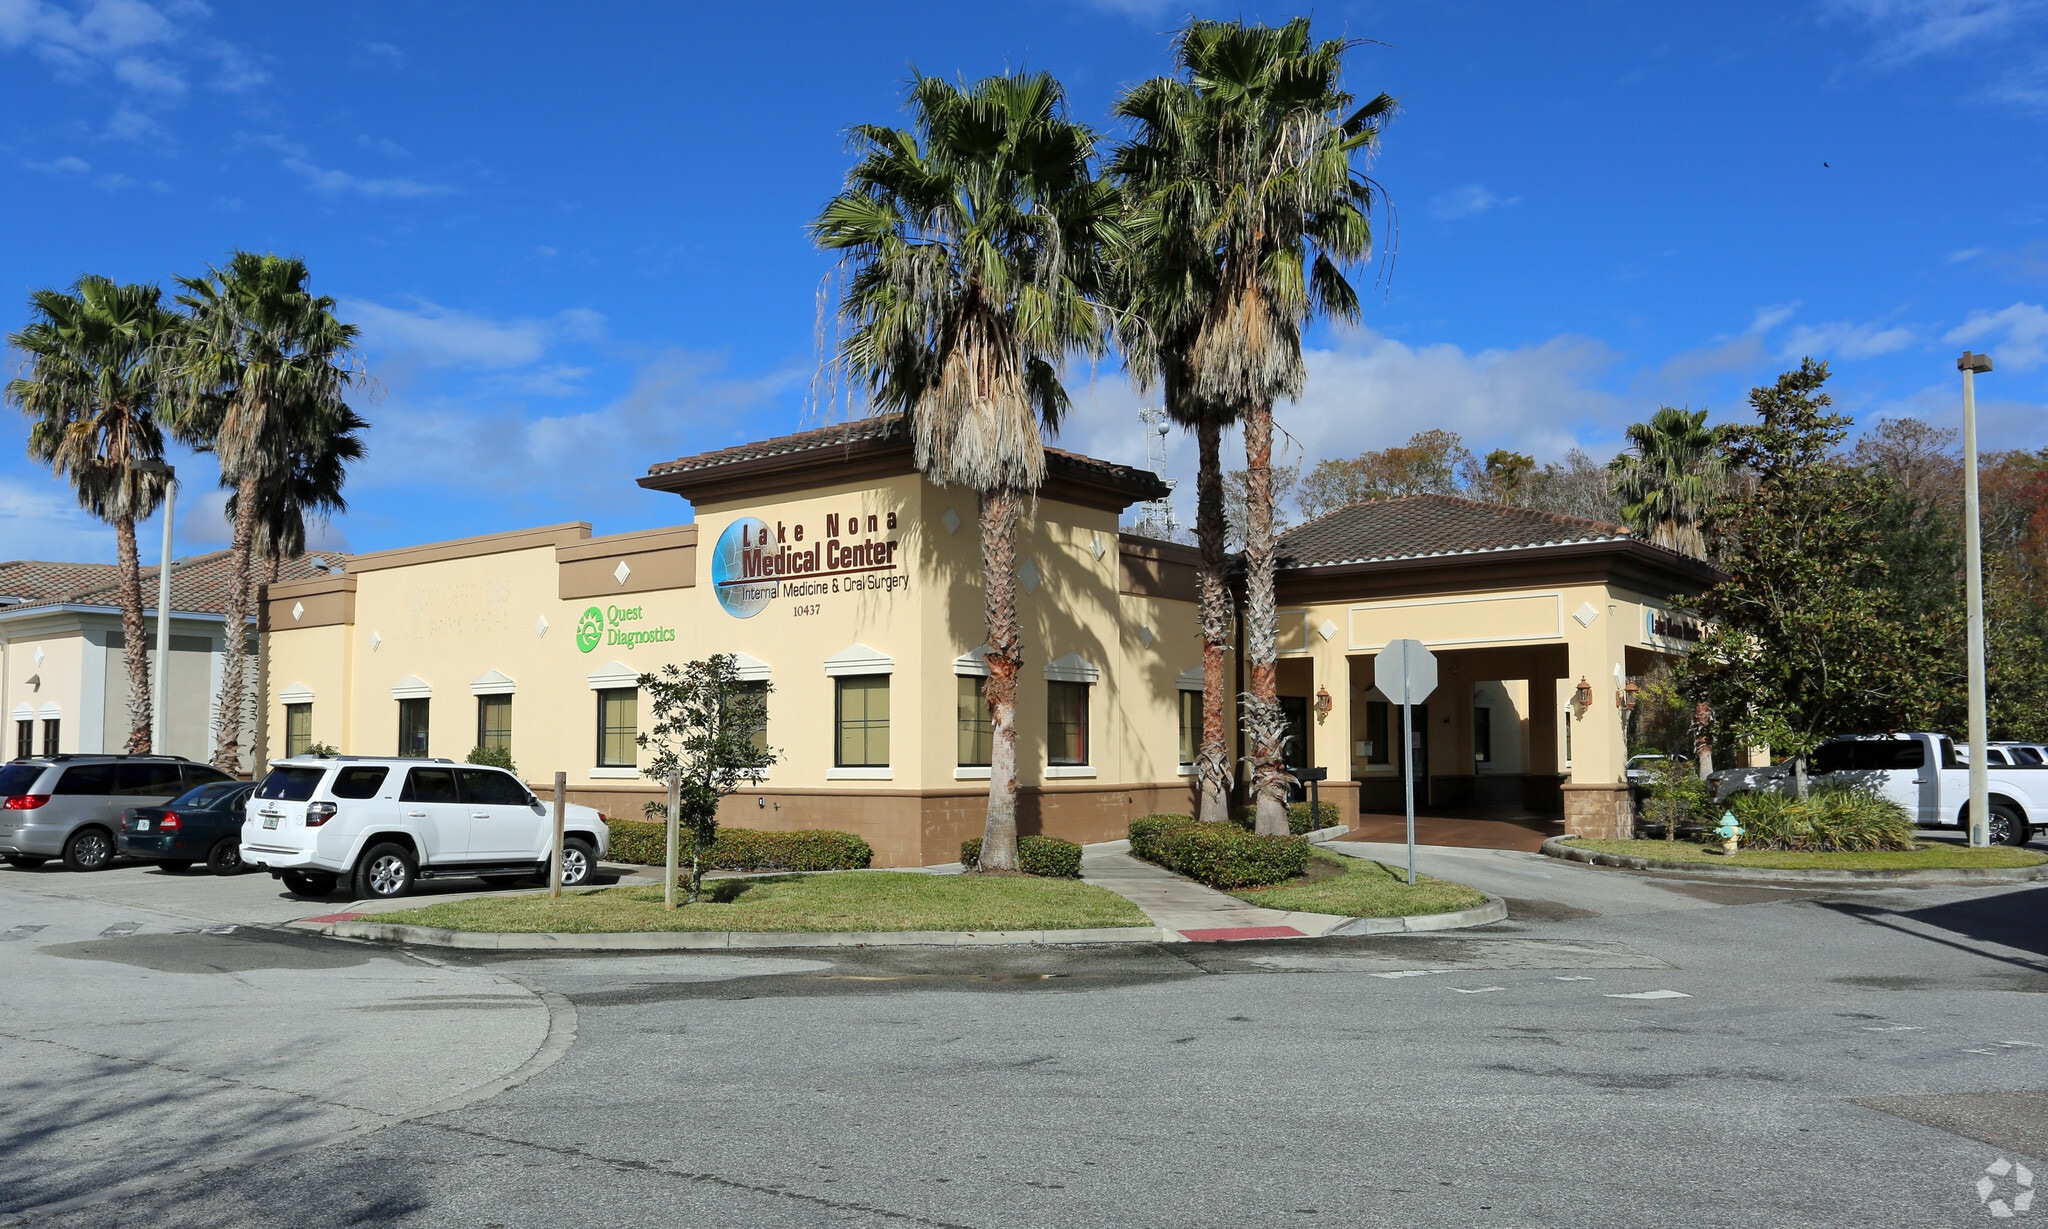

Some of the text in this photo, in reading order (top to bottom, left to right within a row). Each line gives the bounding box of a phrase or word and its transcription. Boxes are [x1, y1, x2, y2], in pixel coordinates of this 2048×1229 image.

[743, 511, 897, 547] Lake Nona
[743, 539, 898, 578] Medical Center
[742, 574, 909, 601] Internal Medicine & Oral Surgery
[607, 605, 643, 626] Quest
[793, 604, 821, 617] 10437
[607, 626, 675, 650] Diagnostics
